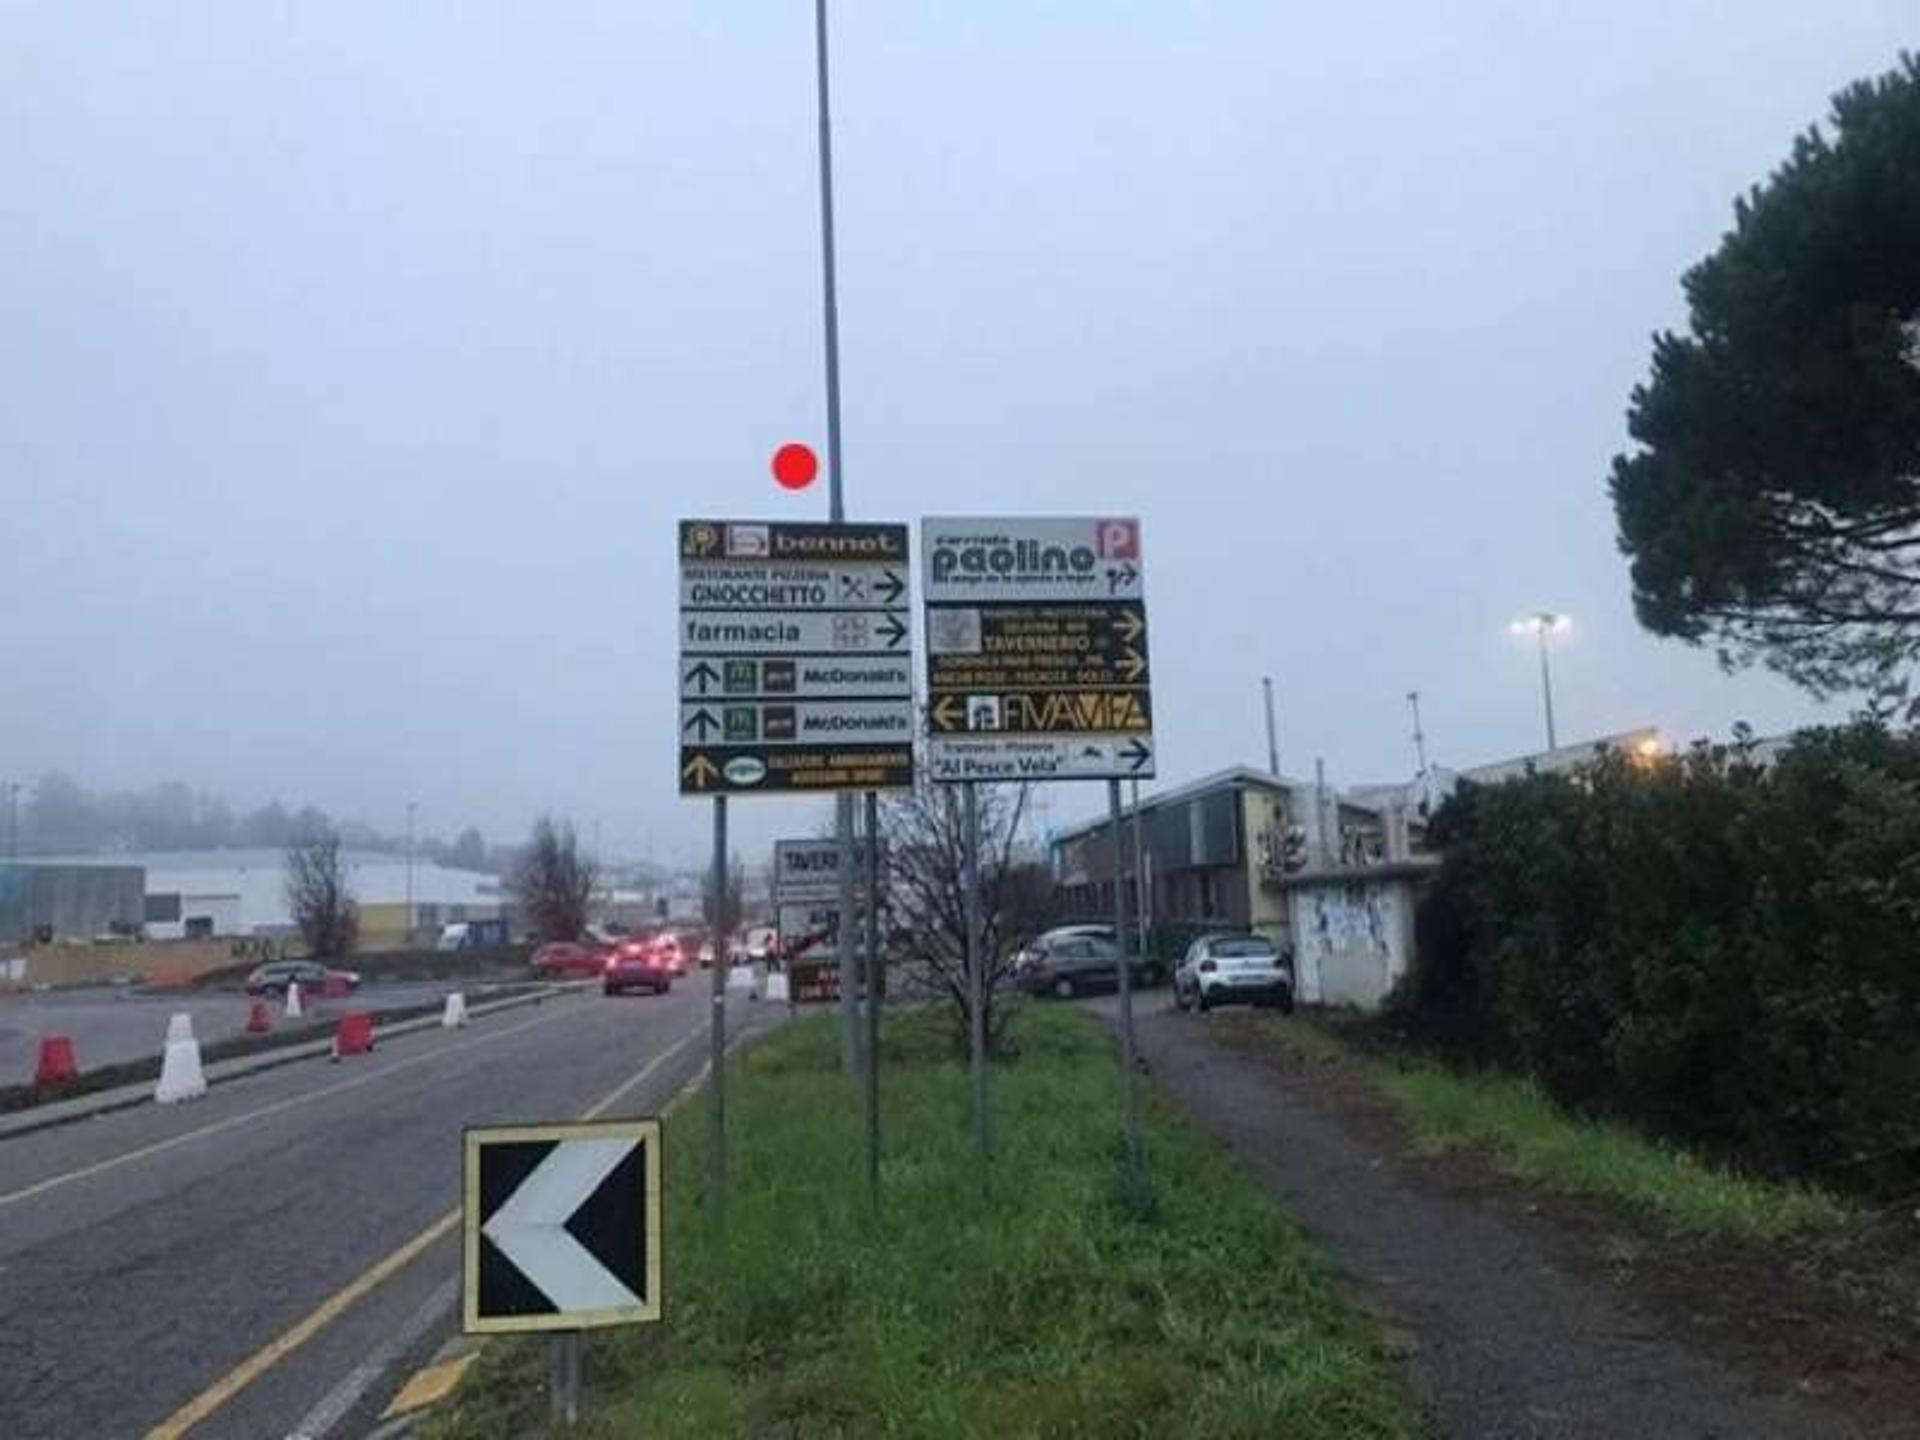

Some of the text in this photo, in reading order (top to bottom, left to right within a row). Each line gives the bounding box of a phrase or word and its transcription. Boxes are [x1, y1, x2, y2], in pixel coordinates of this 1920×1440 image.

[933, 539, 1095, 582] paolino
[692, 584, 827, 604] GNOCCHETTO
[687, 620, 800, 642] farmacia
[803, 668, 907, 684] McDonald's
[803, 714, 908, 731] McDonald's
[963, 758, 1015, 774] Pesce
